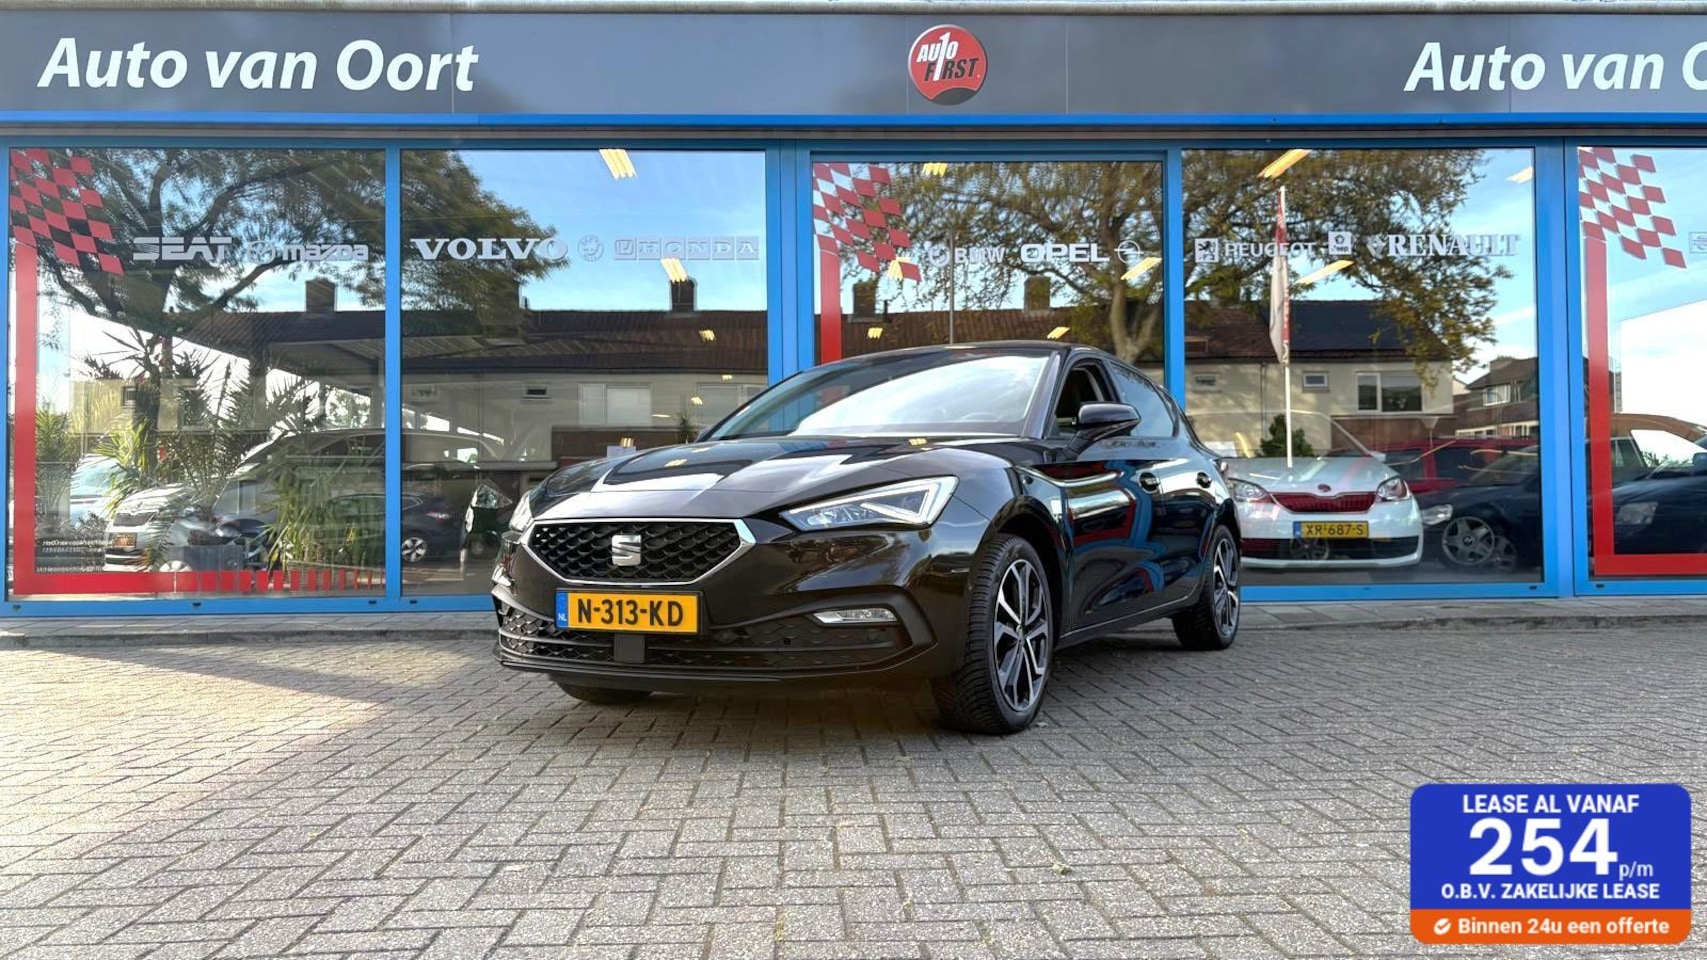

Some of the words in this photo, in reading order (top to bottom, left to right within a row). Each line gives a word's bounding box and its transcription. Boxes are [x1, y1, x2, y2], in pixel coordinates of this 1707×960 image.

[37, 37, 188, 88] Auto
[206, 51, 318, 89] van
[336, 39, 480, 91] Oort
[1403, 42, 1546, 92] Auto
[1562, 53, 1665, 91] van
[133, 237, 232, 260] SEAT
[410, 238, 568, 260] VOLVO
[639, 239, 759, 258] HONDA
[955, 247, 1006, 263] BMW
[1020, 243, 1110, 262] OPEL
[1225, 242, 1317, 257] PEUGEOT
[1387, 234, 1521, 257] RENAULT
[558, 613, 568, 621] NL
[577, 598, 684, 627] N-313-KD
